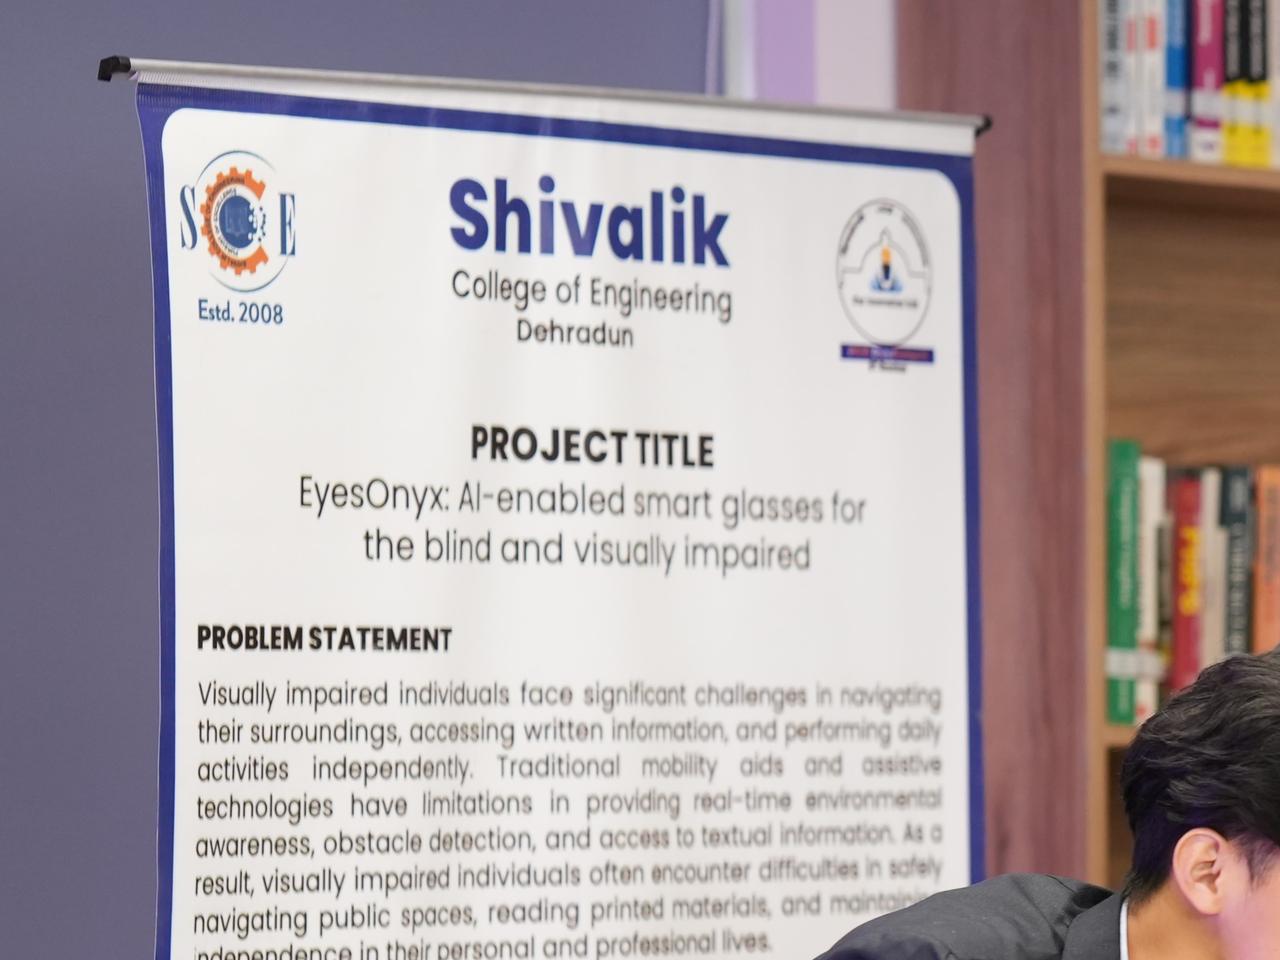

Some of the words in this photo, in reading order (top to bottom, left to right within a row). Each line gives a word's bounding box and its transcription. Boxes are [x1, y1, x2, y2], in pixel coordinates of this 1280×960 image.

[449, 175, 730, 268] Shivalik
[198, 299, 234, 322] Estd.
[239, 302, 283, 324] 2008
[452, 269, 546, 312] College
[556, 274, 580, 304] of
[591, 277, 732, 325] Engineering
[517, 318, 633, 347] Dehradun
[472, 425, 628, 464] PROJECT
[635, 432, 714, 468] TITLE
[300, 476, 448, 520] EyesOnyx:
[459, 481, 624, 516] AI-enabled
[634, 490, 712, 519] smart
[721, 488, 823, 531] glasses
[831, 490, 866, 524] for
[364, 528, 414, 560] the
[426, 529, 490, 562] blind
[501, 533, 563, 564] and
[574, 532, 676, 576] visually
[685, 534, 810, 578] impaired
[198, 625, 303, 650] PROBLEM
[309, 626, 452, 651] STATEMENT
[199, 680, 276, 713] Visually
[287, 680, 387, 713] impaired
[400, 680, 509, 706] individuals
[521, 681, 573, 706] face
[584, 681, 686, 714] significant
[694, 683, 807, 715] challenges
[198, 718, 243, 743] their
[251, 718, 401, 750] surroundings,
[410, 717, 515, 750] accessing
[524, 718, 603, 742] written
[612, 717, 728, 744] information,
[198, 756, 288, 781] activities
[313, 755, 472, 787] independently.
[497, 754, 620, 778] Traditional
[642, 753, 718, 784] mobility
[197, 793, 333, 826] technologies
[351, 793, 407, 817] have
[423, 790, 532, 816] limitations
[550, 789, 569, 813] in
[587, 788, 680, 821] providing
[694, 789, 792, 813] real-time
[196, 837, 314, 858] awareness,
[324, 829, 422, 855] obstacle
[429, 827, 536, 853] detection,
[546, 826, 591, 850] and
[600, 829, 670, 849] access
[676, 826, 695, 849] to
[701, 824, 772, 848] textual
[195, 870, 254, 898] result,
[262, 868, 345, 899] visually
[355, 865, 450, 898] impaired
[458, 862, 580, 888] individuals
[589, 860, 644, 886] often
[651, 861, 751, 884] encounter
[194, 906, 307, 940] navigating
[320, 904, 390, 937] public
[401, 906, 477, 935] spaces,
[489, 898, 579, 930] reading
[591, 896, 664, 929] printed
[672, 893, 772, 919] materials,
[543, 934, 588, 959] and
[722, 929, 771, 953] lives.
